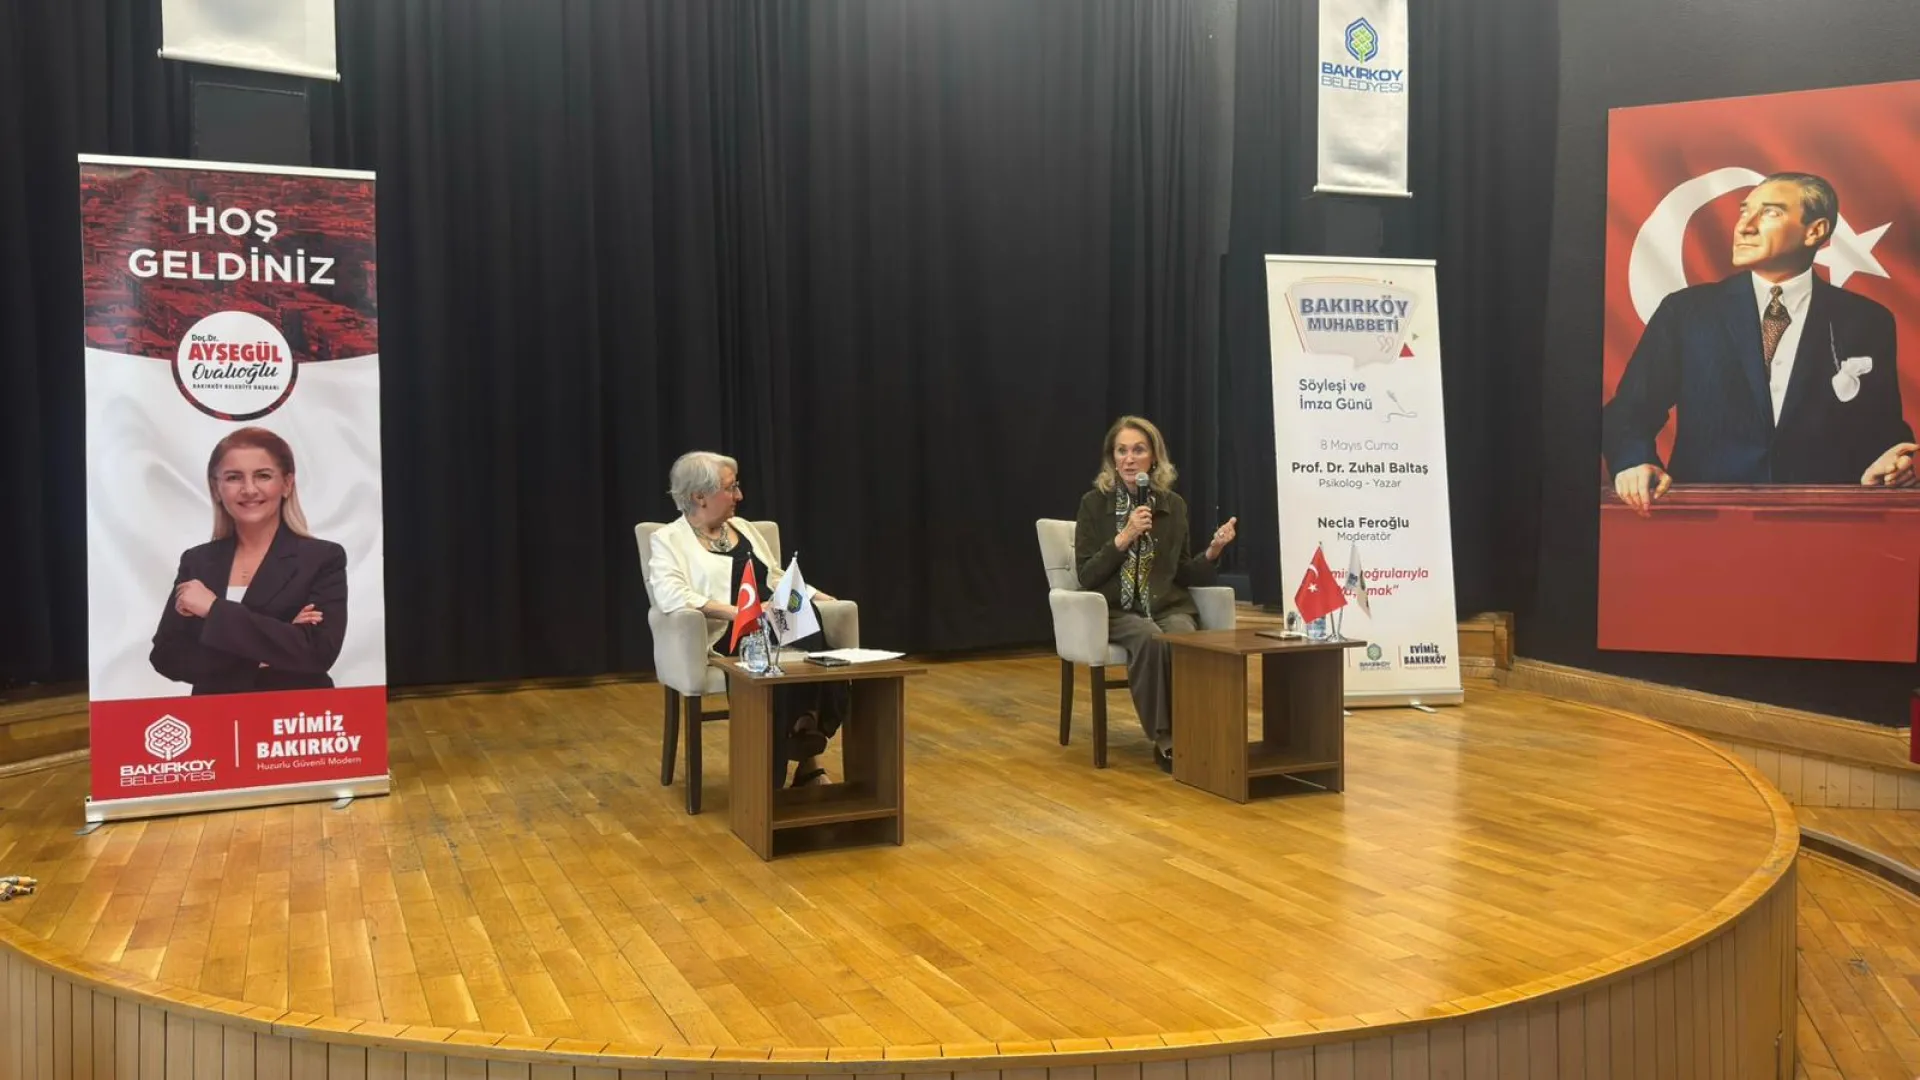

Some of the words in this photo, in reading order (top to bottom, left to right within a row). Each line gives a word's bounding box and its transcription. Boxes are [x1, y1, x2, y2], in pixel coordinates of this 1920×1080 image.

[187, 206, 279, 243] HOŞ
[127, 246, 336, 286] GELDİNİZ
[1300, 294, 1409, 317] BAKIRKÖY
[1307, 316, 1400, 333] MUHABBETİ
[188, 341, 283, 365] AYŞEGÜL
[192, 361, 279, 384] Ovalıoğlu
[1299, 378, 1347, 395] Söyleşi
[1350, 382, 1367, 392] ve
[1299, 395, 1333, 410] İmza
[1336, 398, 1373, 411] Günü
[1320, 440, 1328, 450] 8
[1330, 440, 1362, 453] Mayıs
[1364, 440, 1399, 450] Cuma
[1292, 462, 1323, 474] Prof.
[1326, 462, 1345, 474] Dr.
[1349, 462, 1385, 474] Zuhal
[1389, 462, 1429, 475] Baltaş
[1319, 478, 1363, 490] Psikolog
[1373, 479, 1402, 488] Yazar
[1318, 517, 1355, 529] Necla
[1359, 516, 1410, 530] Feroğlu
[1337, 531, 1392, 541] Moderatör
[1363, 567, 1429, 581] oğrularıyla
[1404, 653, 1447, 665] BAKIRKÖY
[273, 709, 344, 736] EVİMİZ
[256, 731, 362, 759] BAKIRKÖY
[256, 761, 291, 771] Huzurlu
[292, 758, 326, 768] Güvenli
[328, 756, 362, 766] Modern
